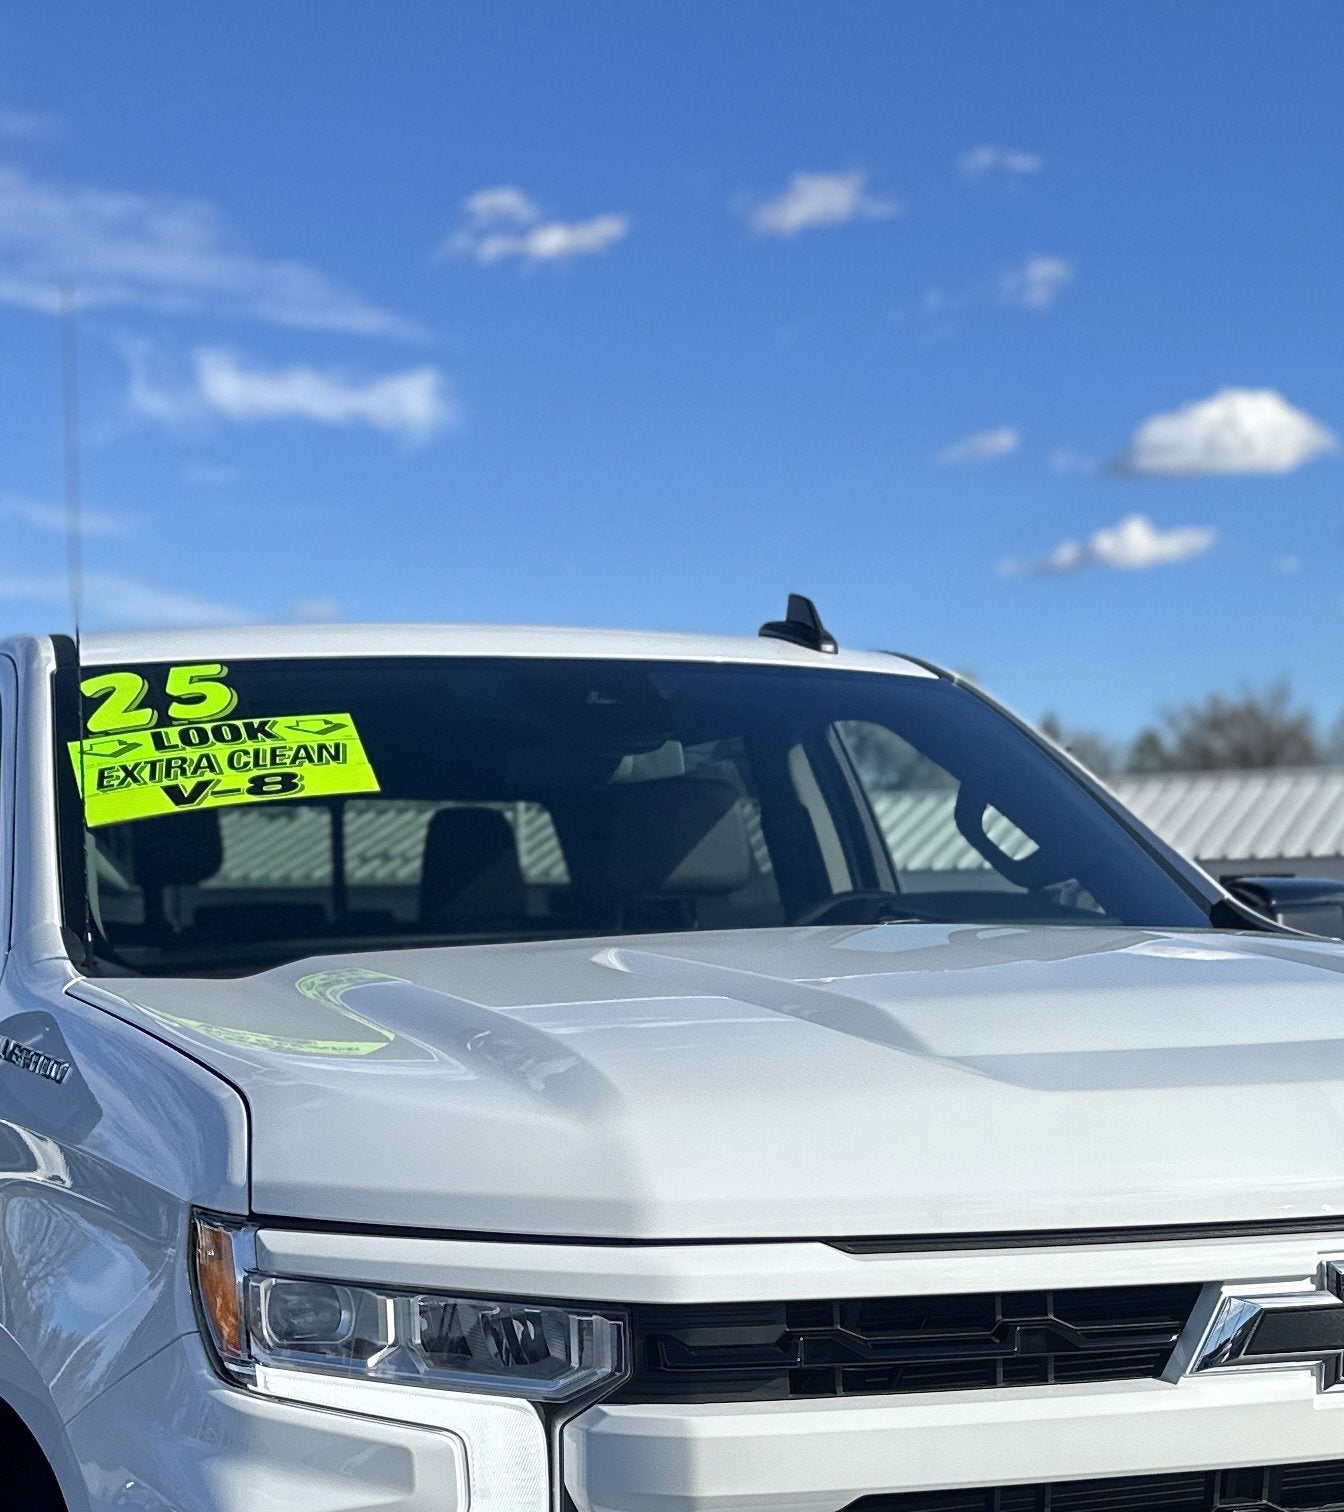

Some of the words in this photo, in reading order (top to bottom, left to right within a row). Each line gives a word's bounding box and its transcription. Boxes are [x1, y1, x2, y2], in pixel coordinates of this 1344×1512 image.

[80, 664, 237, 734] 25
[150, 720, 283, 753] LOOK
[96, 752, 223, 793] EXTRA
[227, 742, 347, 773] CLEAN
[160, 772, 304, 807] V-8
